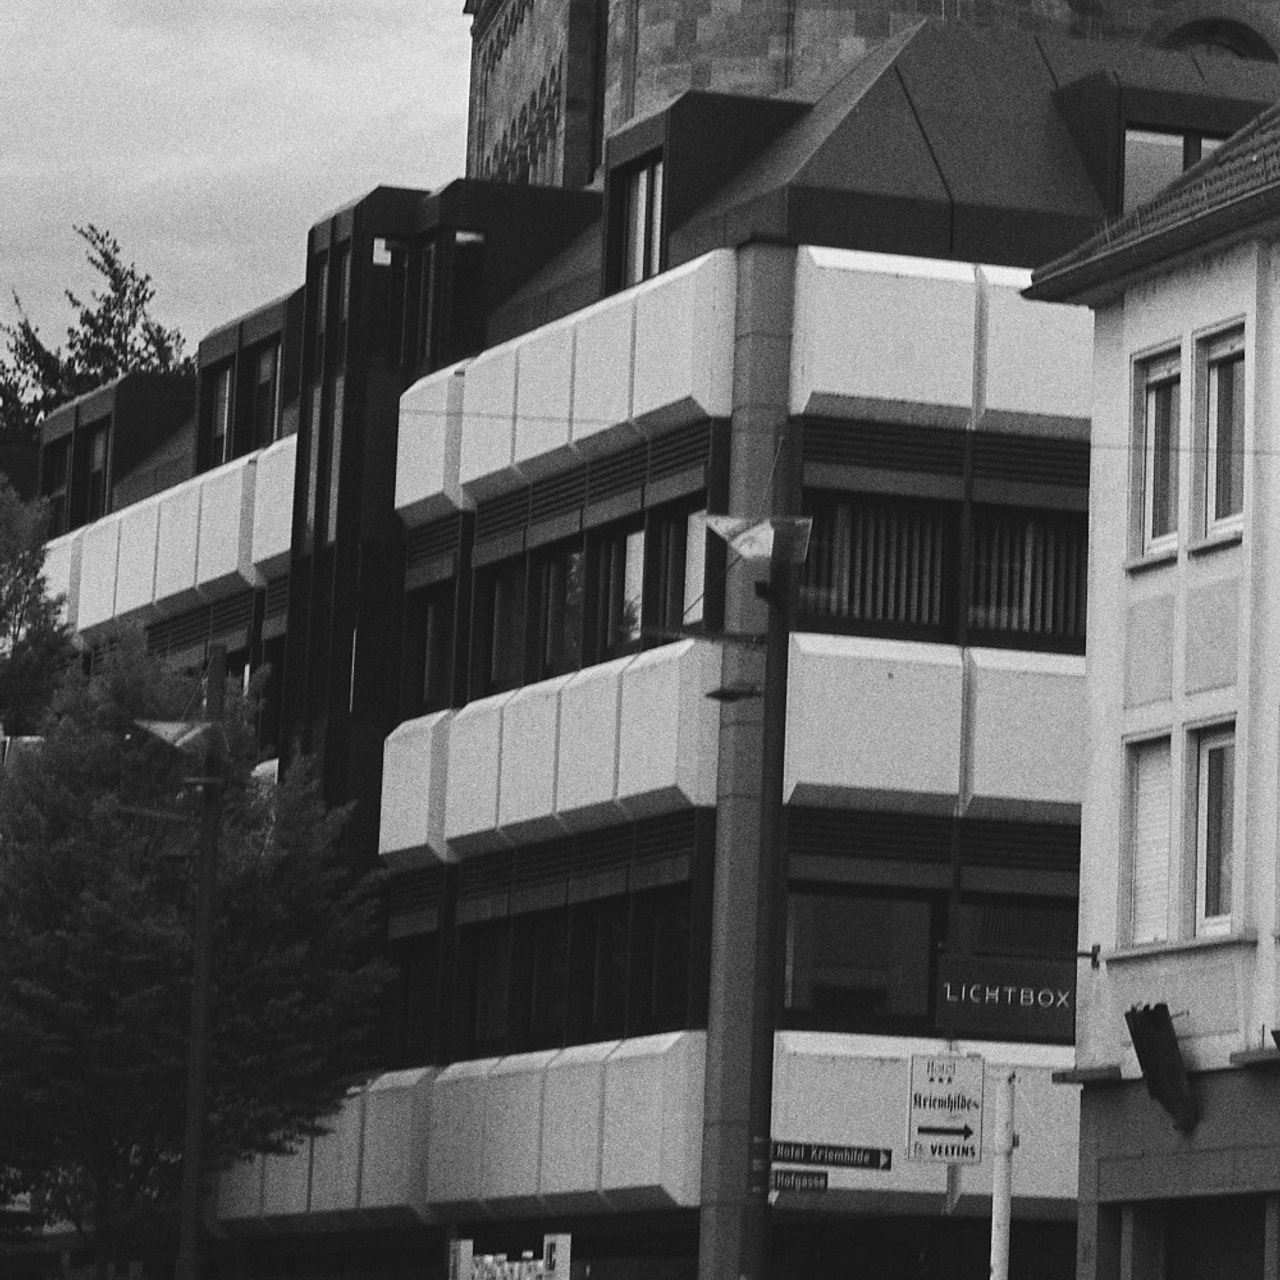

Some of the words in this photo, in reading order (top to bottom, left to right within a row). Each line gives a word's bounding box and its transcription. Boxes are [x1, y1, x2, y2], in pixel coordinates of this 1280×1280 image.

[943, 982, 1070, 1008] LICHTBOX
[776, 1143, 805, 1160] Hotel
[810, 1145, 871, 1165] Kriemhilde
[776, 1173, 827, 1190] Hofgasse
